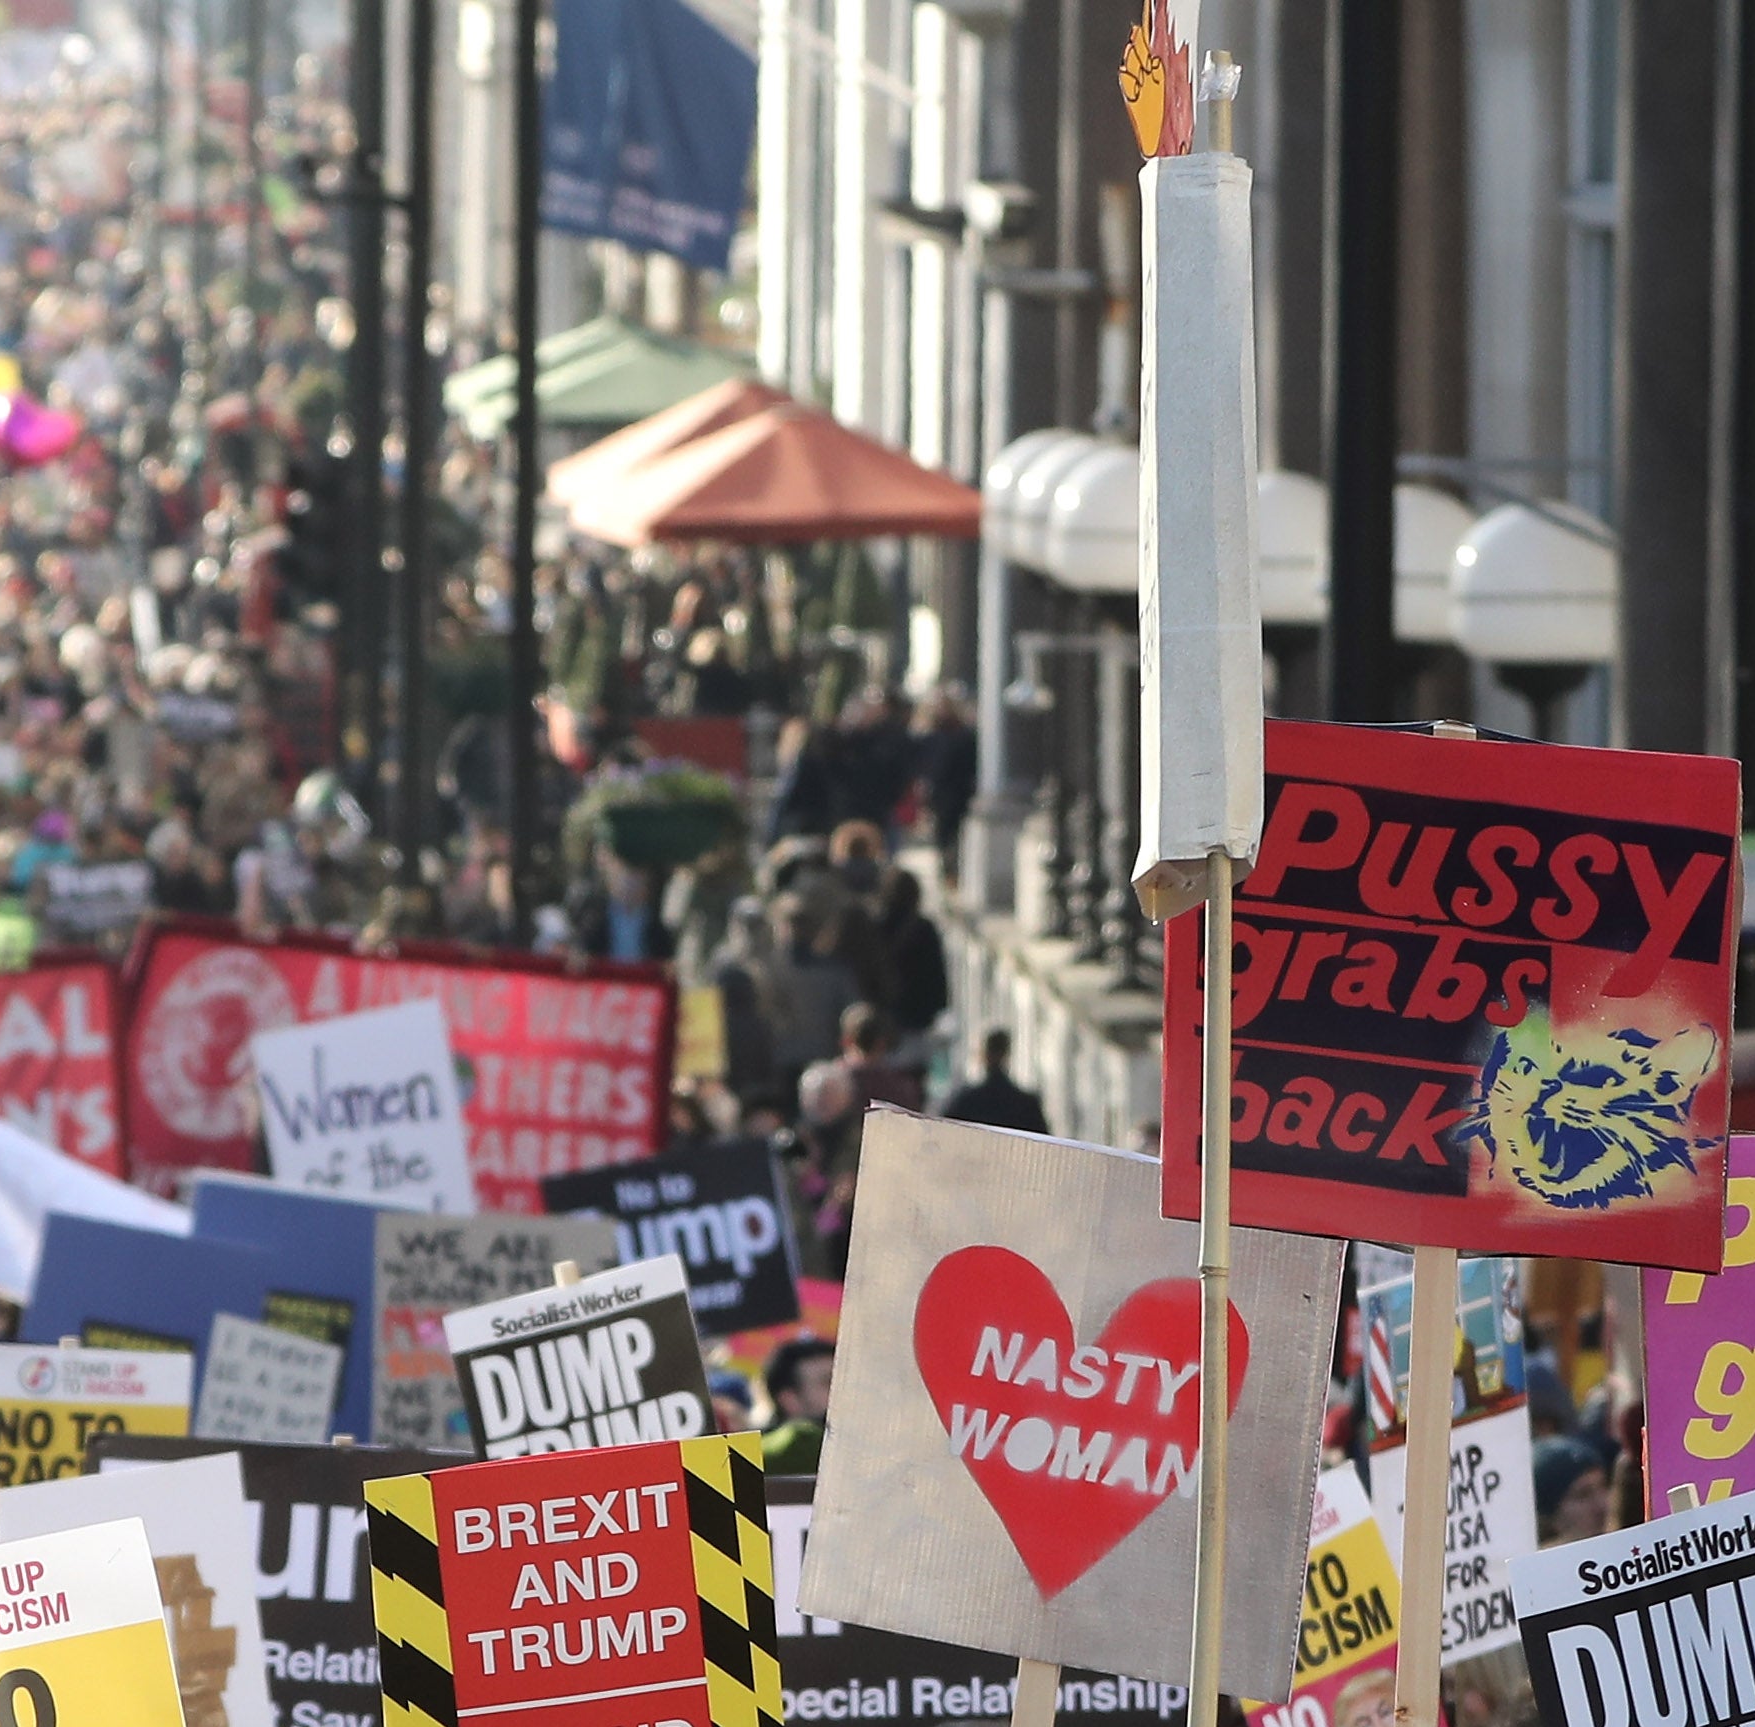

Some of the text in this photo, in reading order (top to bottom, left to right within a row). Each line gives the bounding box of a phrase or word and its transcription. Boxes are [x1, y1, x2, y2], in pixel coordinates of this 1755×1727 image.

[1242, 782, 1726, 998] Pussy
[1199, 924, 1548, 1030] grabs
[261, 1044, 440, 1145] Women
[366, 1138, 433, 1192] the
[613, 1195, 779, 1278] ump
[492, 1299, 579, 1339] Socialist
[577, 1284, 644, 1317] Worker
[470, 1316, 657, 1441] DUMP
[971, 1325, 1200, 1415] NASTY
[949, 1402, 1201, 1499] WOMAN
[453, 1482, 679, 1554] BREXIT
[0, 1559, 45, 1600] UP
[510, 1552, 640, 1610] AND
[1446, 1555, 1490, 1594] FOR
[1577, 1536, 1695, 1597] Socialist
[468, 1607, 688, 1675] TRUMP
[1294, 1584, 1394, 1674] CISM
